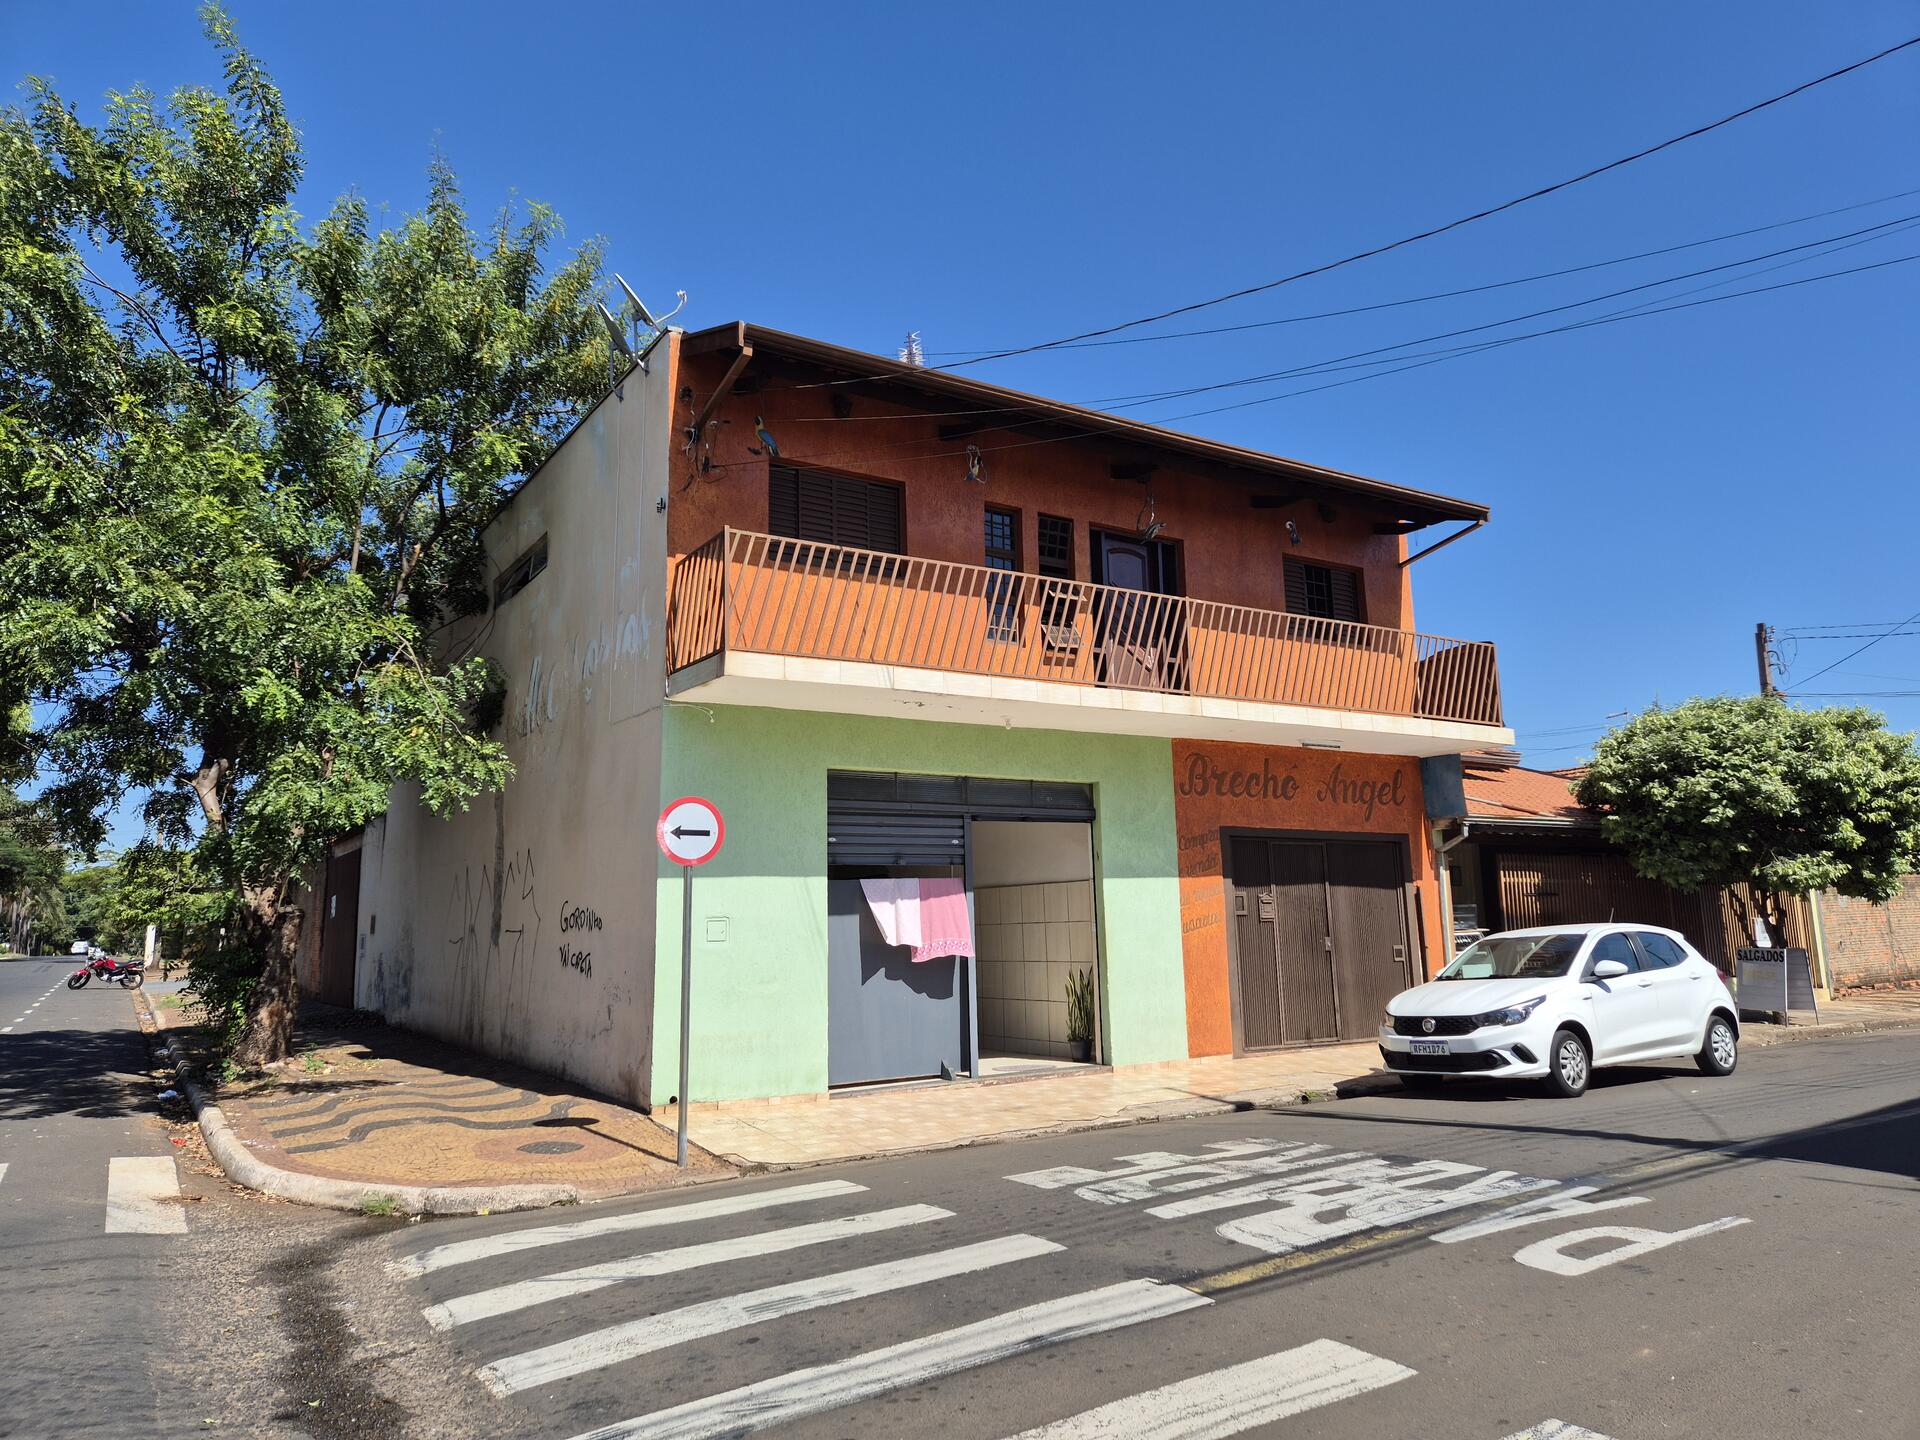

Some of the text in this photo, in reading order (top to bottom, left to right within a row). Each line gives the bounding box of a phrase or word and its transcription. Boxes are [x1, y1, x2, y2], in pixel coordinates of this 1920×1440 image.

[1179, 752, 1406, 823] Brechó Angel
[1737, 949, 1784, 963] SALGADOS
